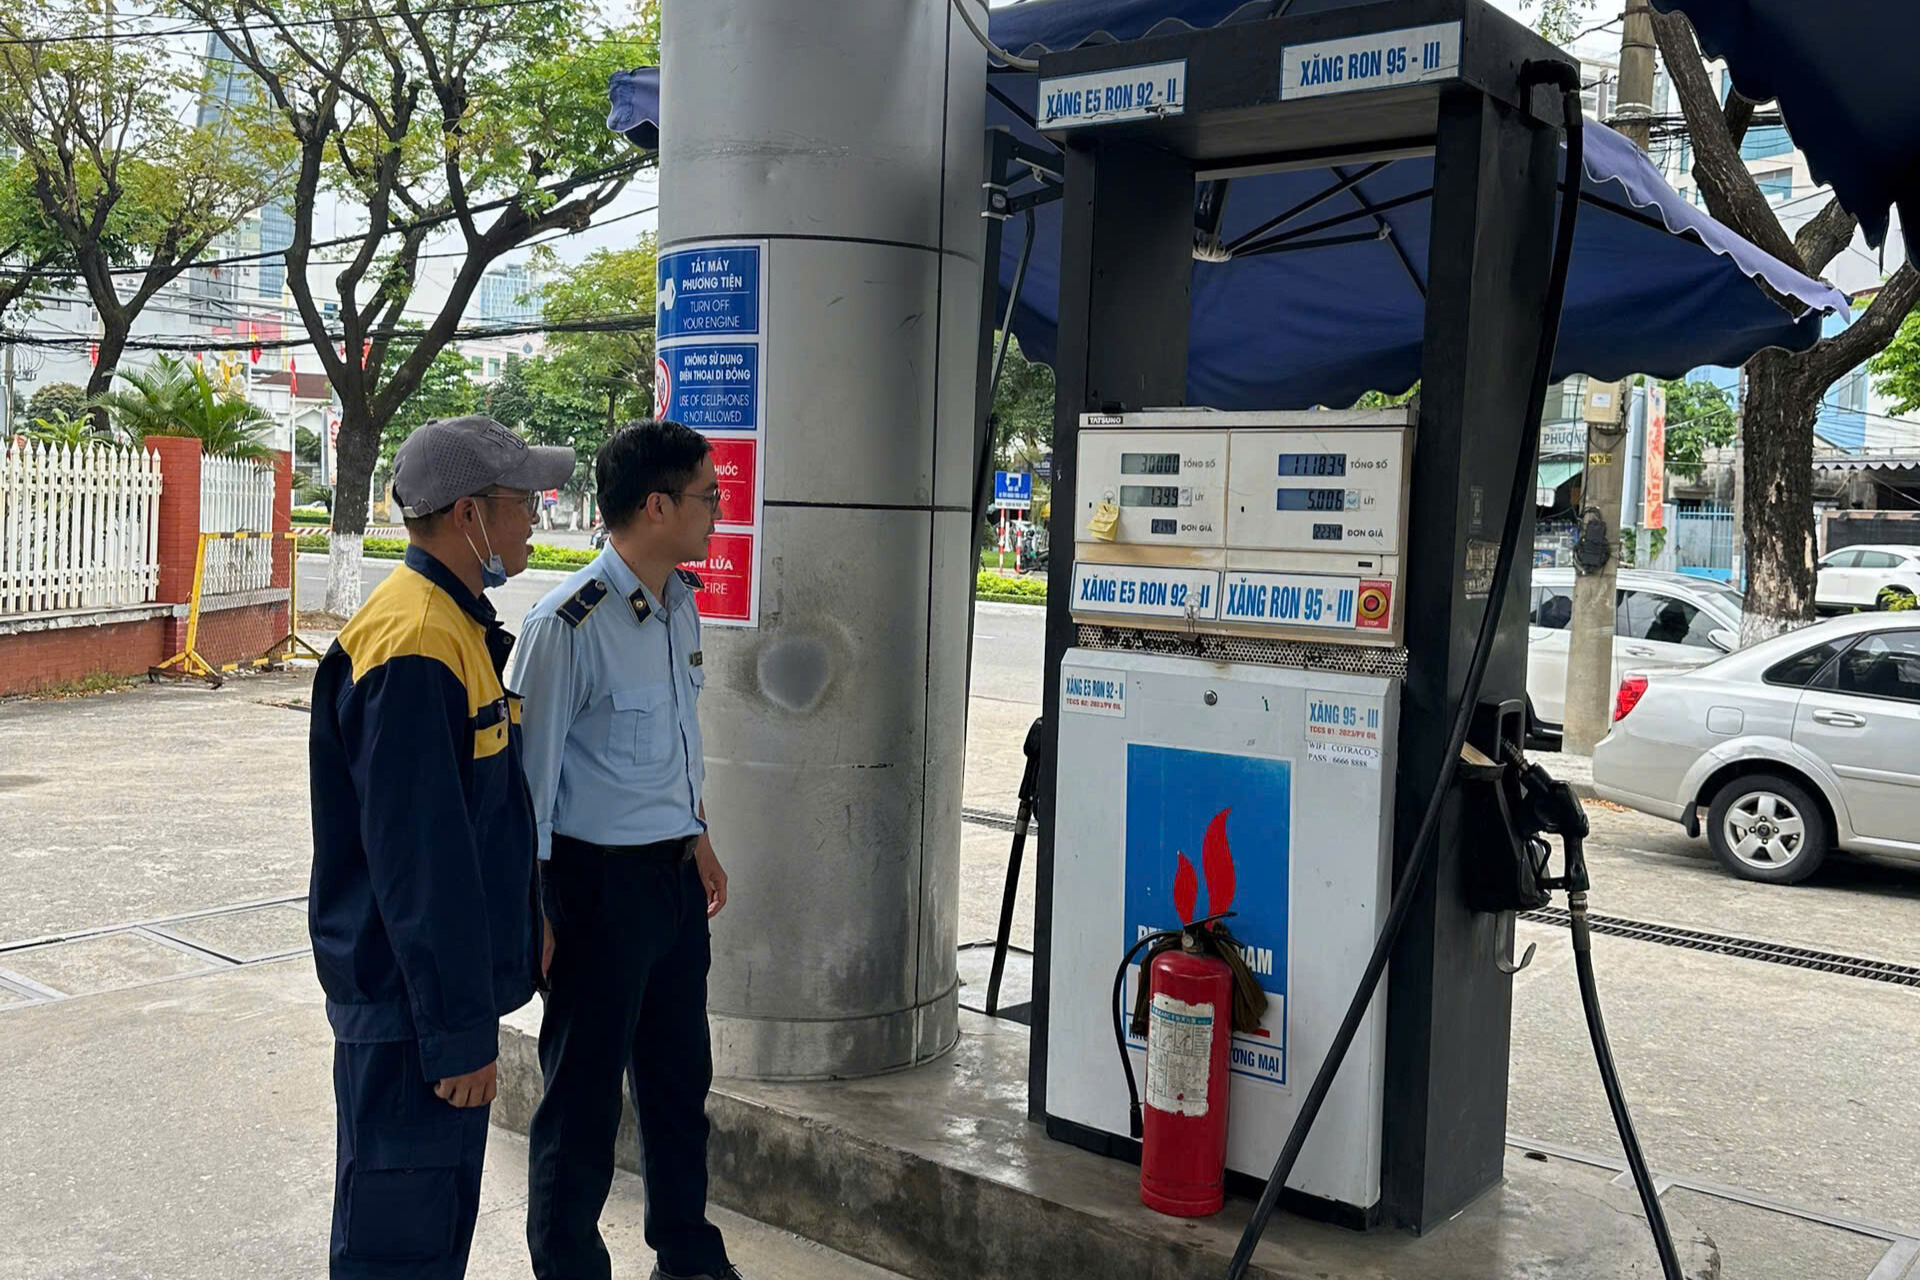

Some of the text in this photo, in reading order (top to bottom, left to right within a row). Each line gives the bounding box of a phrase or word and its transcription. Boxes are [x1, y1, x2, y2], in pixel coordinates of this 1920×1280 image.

[1300, 54, 1344, 87] XĂNG
[1348, 51, 1381, 80] RON
[1386, 46, 1407, 74] 95
[1423, 41, 1441, 70] III
[1047, 88, 1081, 118] XĂNG
[1085, 89, 1101, 113] E5
[1105, 84, 1133, 110] RON
[1137, 81, 1153, 106] 92
[1167, 78, 1177, 102] II
[691, 257, 729, 273] TẮT MÁY
[682, 274, 742, 292] PHƯƠNG TIỆN
[690, 299, 729, 313] TURN OFF
[683, 316, 740, 330] YOUR ENGINE
[684, 352, 743, 369] KHÔNG SỬ DỤNG
[680, 367, 750, 384] ĐIỆN THOẠI DI ĐỘNG
[680, 394, 749, 407] USE OF CELLPHONES
[684, 410, 742, 422] IS NOT ALLOWED
[1089, 416, 1122, 424] TATSUNO
[714, 461, 738, 476] HUỐC
[1205, 458, 1216, 468] SỐ
[1294, 456, 1345, 475] 111834
[1376, 459, 1388, 469] SỐ
[1363, 497, 1374, 505] LÍT
[710, 555, 733, 570] LỬA
[704, 582, 728, 595] FIRE
[1080, 574, 1210, 608] XĂNG E5 RON 92 II
[1227, 578, 1265, 618] XĂNG
[1271, 587, 1301, 620] RON
[1304, 588, 1323, 620] 95
[1337, 589, 1353, 622] III
[1066, 674, 1082, 696] XĂNG
[1084, 679, 1091, 696] E5
[1092, 680, 1105, 698] RON
[1106, 681, 1114, 699] 92
[1309, 700, 1340, 724] XĂNG
[1343, 706, 1356, 726] 95
[1367, 708, 1378, 728] III
[1310, 726, 1325, 734] TCCS
[1367, 731, 1376, 740] OIL
[1232, 1047, 1279, 1076] ƠNG MẠI
